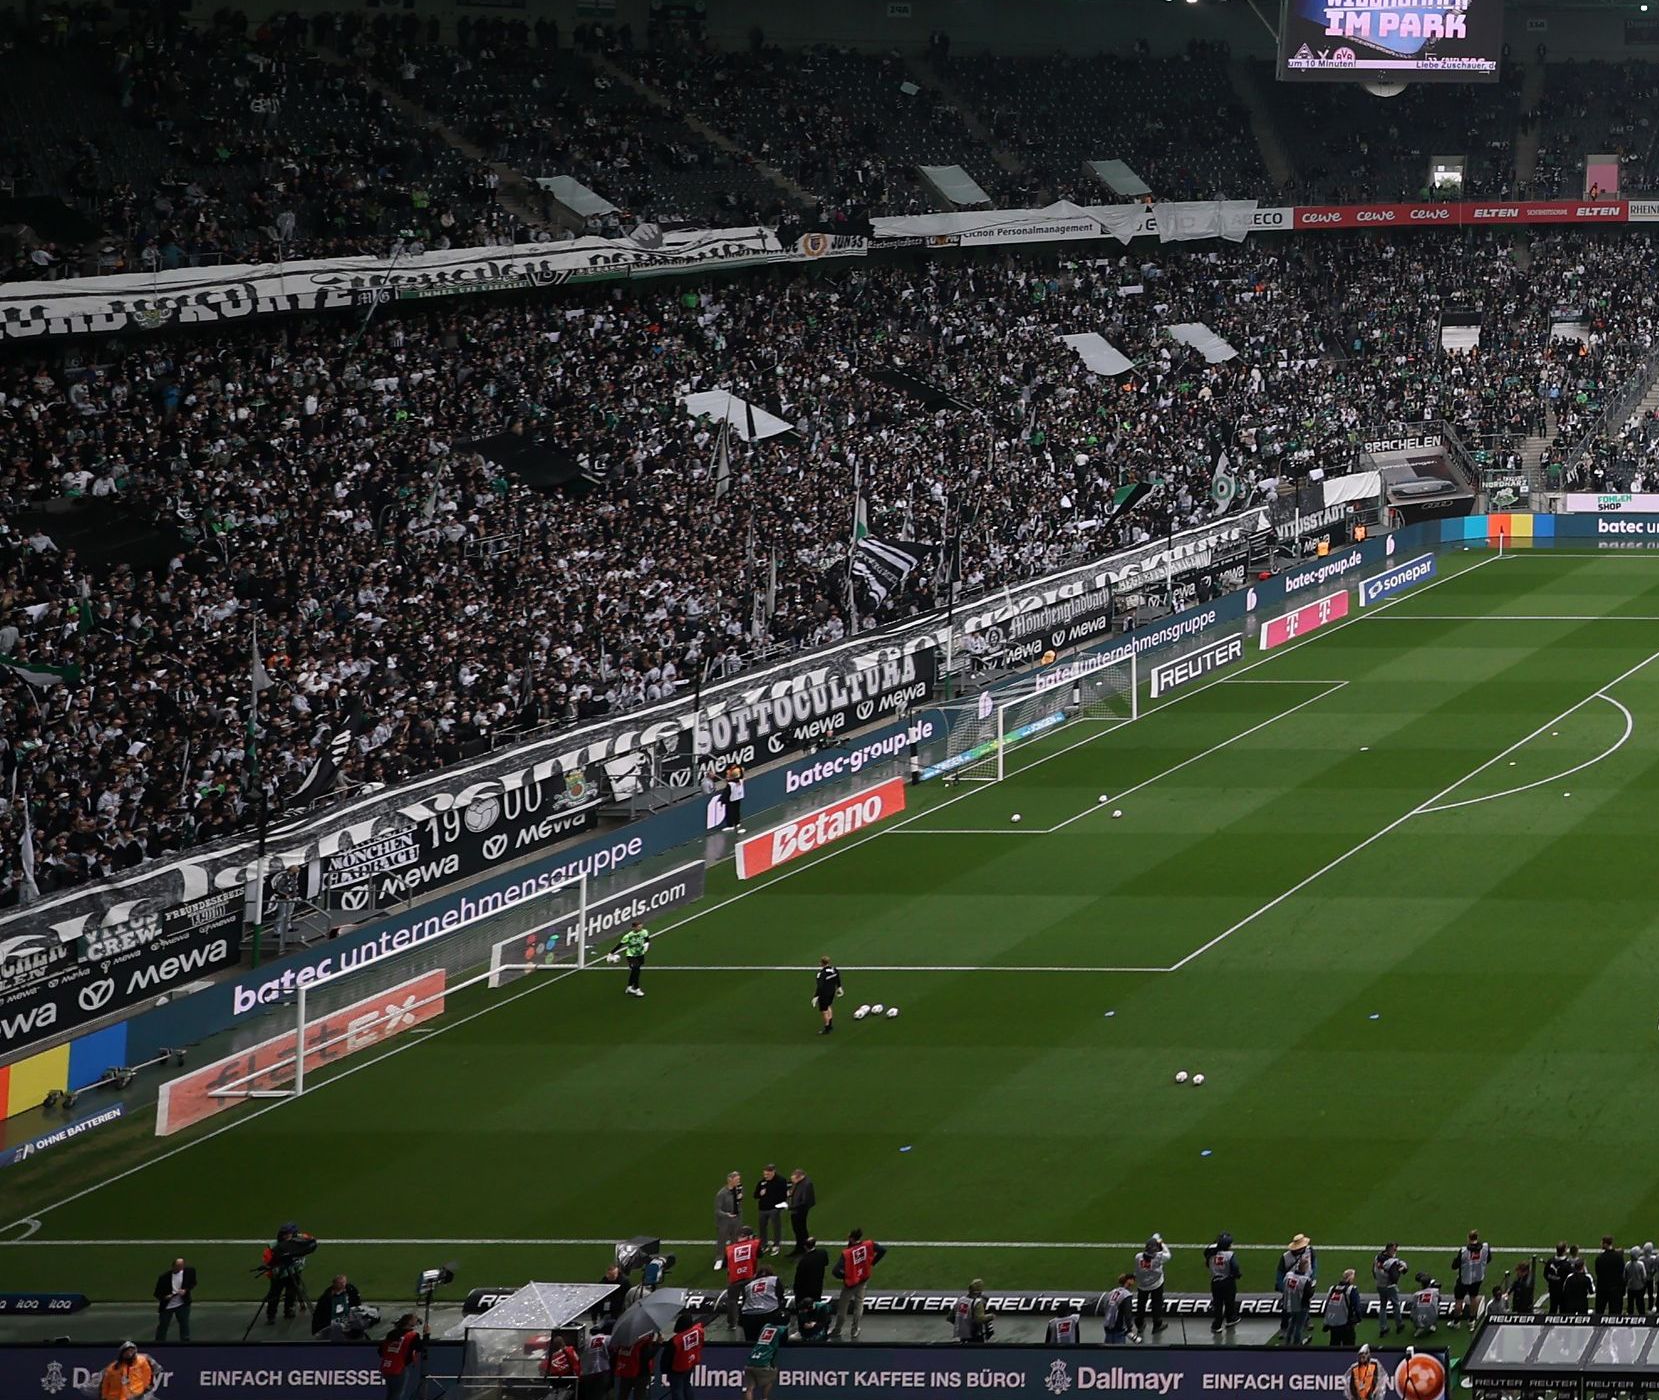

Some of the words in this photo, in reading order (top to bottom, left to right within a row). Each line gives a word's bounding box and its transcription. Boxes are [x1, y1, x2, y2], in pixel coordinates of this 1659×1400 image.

[1325, 11, 1370, 37] IM
[1379, 13, 1467, 39] PARK
[1302, 211, 1343, 223] cewe
[1410, 208, 1450, 220] cewe
[1473, 208, 1520, 218] ELTEN
[1575, 207, 1621, 217] ELTEN
[998, 223, 1093, 237] Personalmanagement
[1597, 502, 1621, 511] SHOP
[1598, 519, 1643, 534] batec
[1285, 551, 1362, 593] batec-group.de
[1384, 559, 1432, 589] sonepar
[1159, 639, 1242, 691] REUTER
[785, 720, 933, 793] batec-group.de
[771, 794, 882, 866] Betano
[165, 886, 245, 921] FREUNDESKREIS
[566, 882, 686, 943] H-Hotels.com
[233, 948, 332, 1015] batec
[340, 837, 644, 970] unternehmensgruppe
[36, 1130, 68, 1150] OHNE
[66, 1108, 122, 1138] BATTERIEN
[863, 1296, 958, 1311] REUTER
[985, 1297, 1085, 1312] REUTER
[1489, 1315, 1534, 1324] REUTER
[199, 1370, 284, 1387] EINFACH
[778, 1370, 848, 1388] BRINGT
[853, 1370, 926, 1388] KAFFEE
[929, 1370, 961, 1388] INS
[965, 1366, 1026, 1388] BÜRO!
[1076, 1366, 1184, 1394] Dallmayr
[1202, 1374, 1283, 1391] EINFACH
